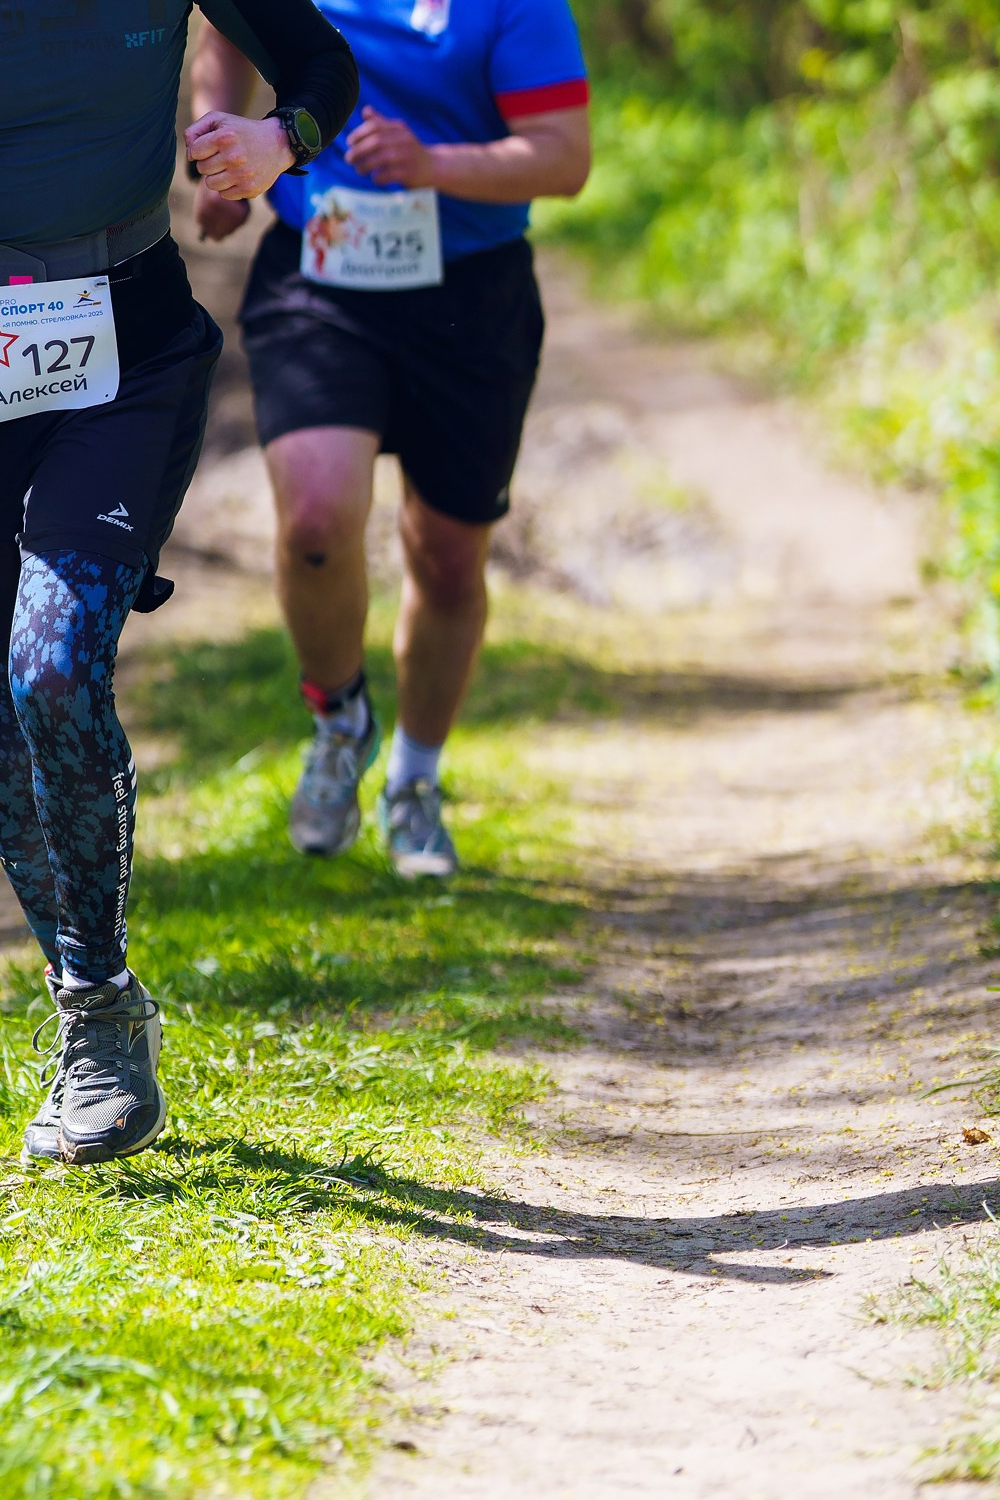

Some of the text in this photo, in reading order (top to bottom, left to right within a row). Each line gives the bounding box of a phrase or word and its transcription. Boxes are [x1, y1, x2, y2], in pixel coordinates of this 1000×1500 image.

[124, 28, 166, 49] XFIT
[367, 231, 423, 260] 125
[1, 301, 64, 316] СПОРТ 40
[88, 309, 104, 318] 2025
[21, 335, 96, 377] 127
[96, 514, 134, 532] DEMIX
[112, 772, 128, 803] feel
[116, 804, 128, 852] strong
[119, 853, 129, 880] and
